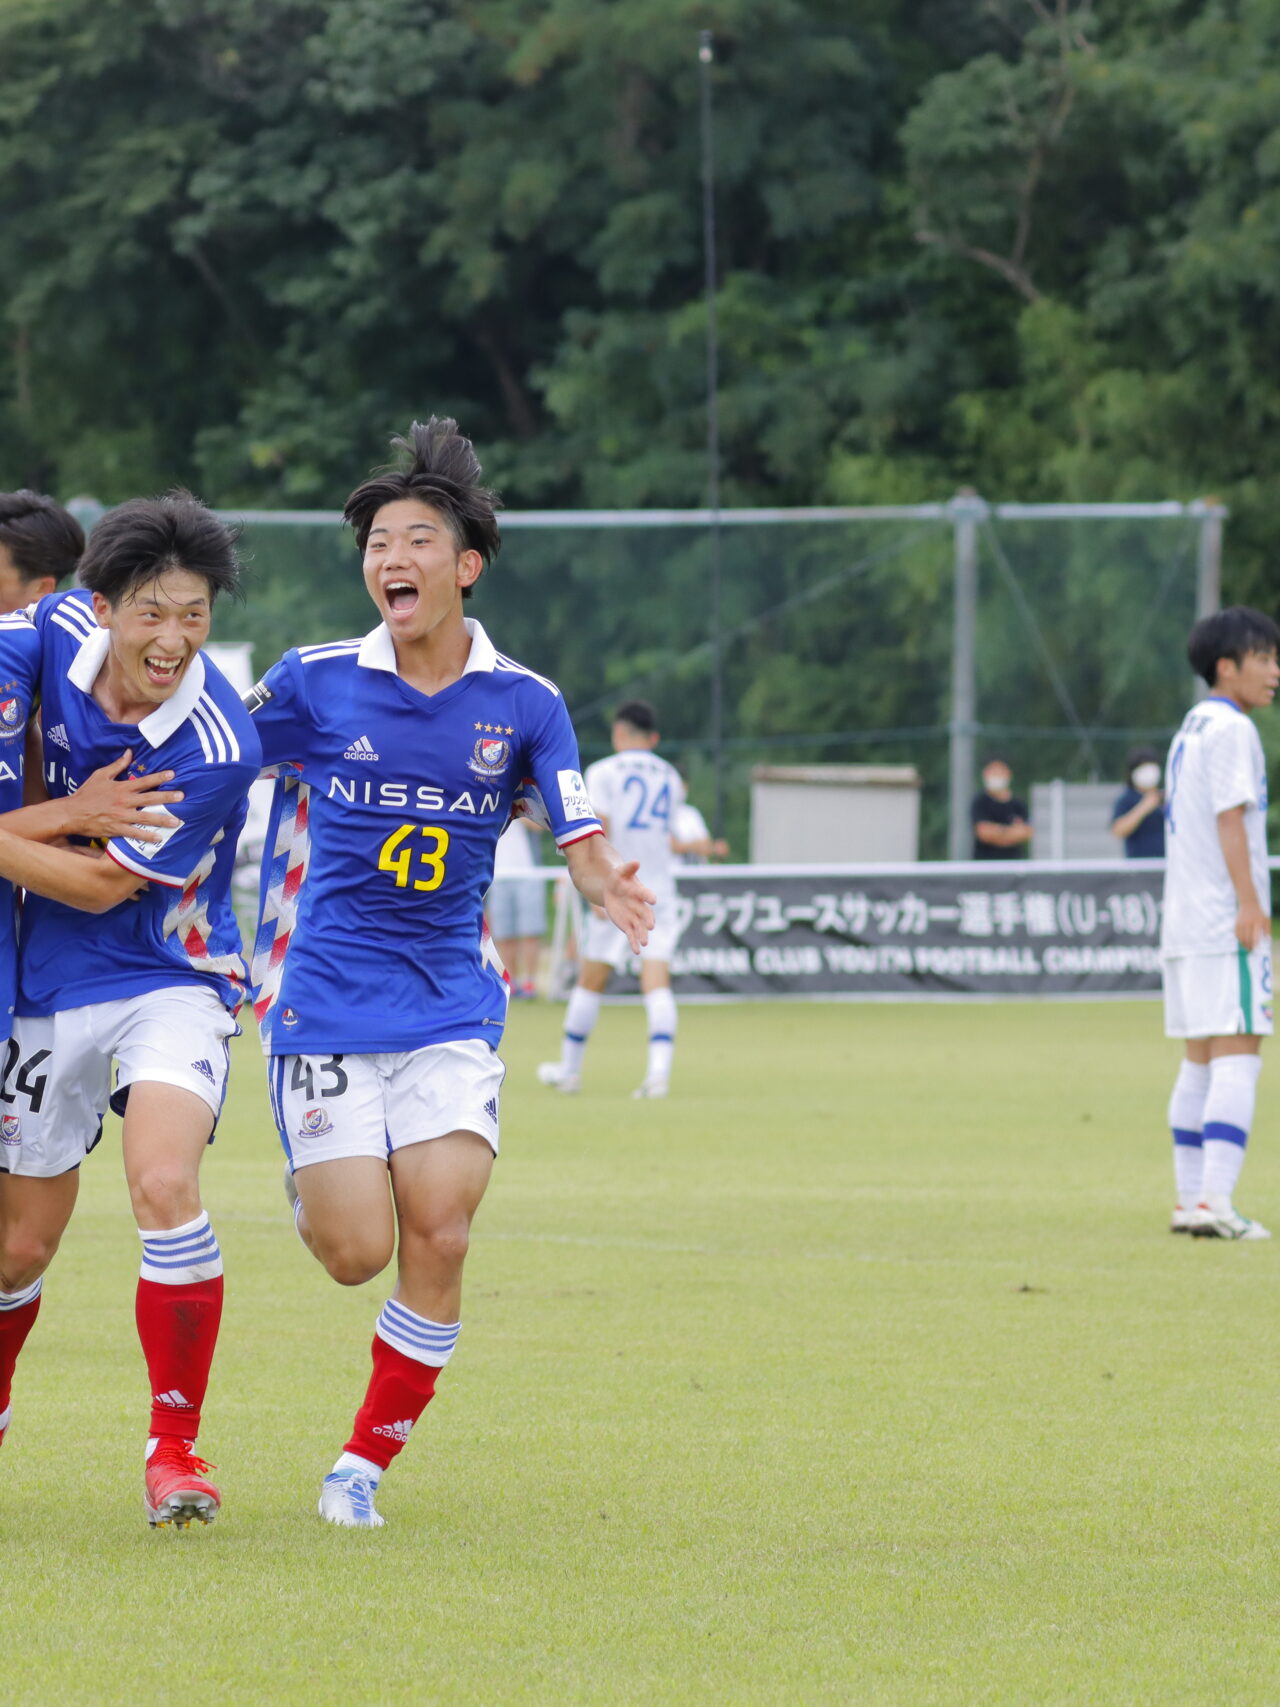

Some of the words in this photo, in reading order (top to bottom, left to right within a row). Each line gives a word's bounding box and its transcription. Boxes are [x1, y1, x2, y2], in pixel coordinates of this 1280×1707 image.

[344, 751, 379, 761] adidas
[327, 776, 501, 815] NISSAN
[623, 775, 671, 833] 24
[377, 824, 450, 892] 43
[0, 1036, 53, 1114] 24
[291, 1054, 349, 1101] 43
[372, 1425, 409, 1443] adida
